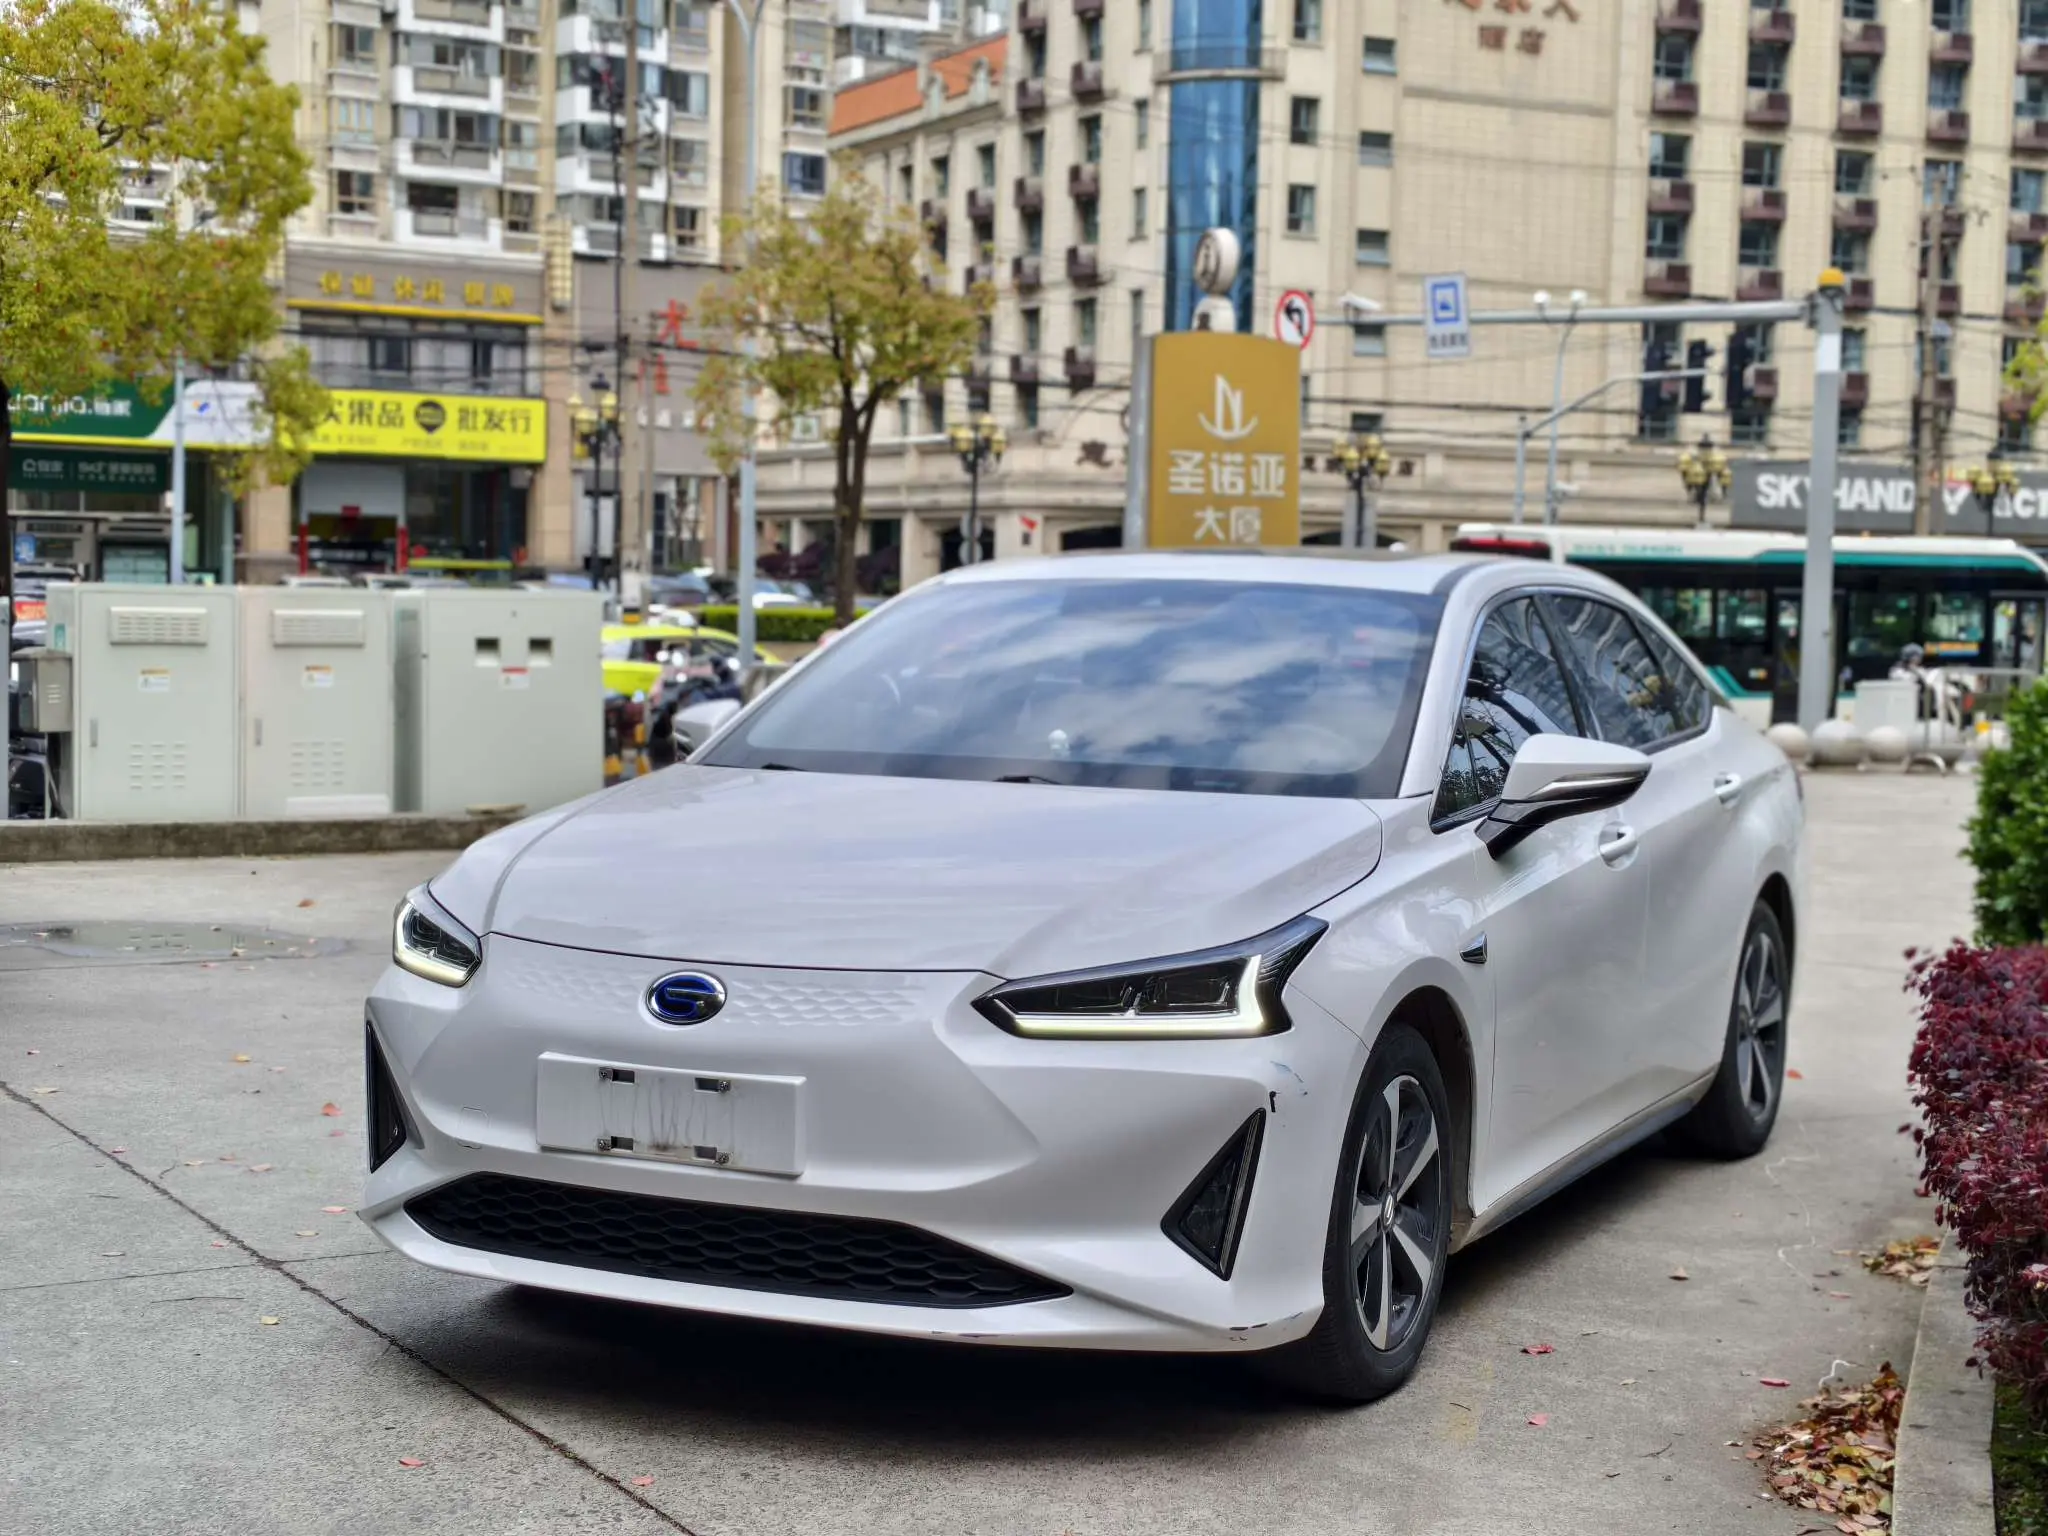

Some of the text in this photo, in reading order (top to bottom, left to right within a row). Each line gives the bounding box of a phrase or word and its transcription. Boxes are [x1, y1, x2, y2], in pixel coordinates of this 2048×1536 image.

[457, 405, 533, 436] 批发行
[1167, 449, 1287, 498] 圣诺亚
[1193, 505, 1262, 544] 大厦
